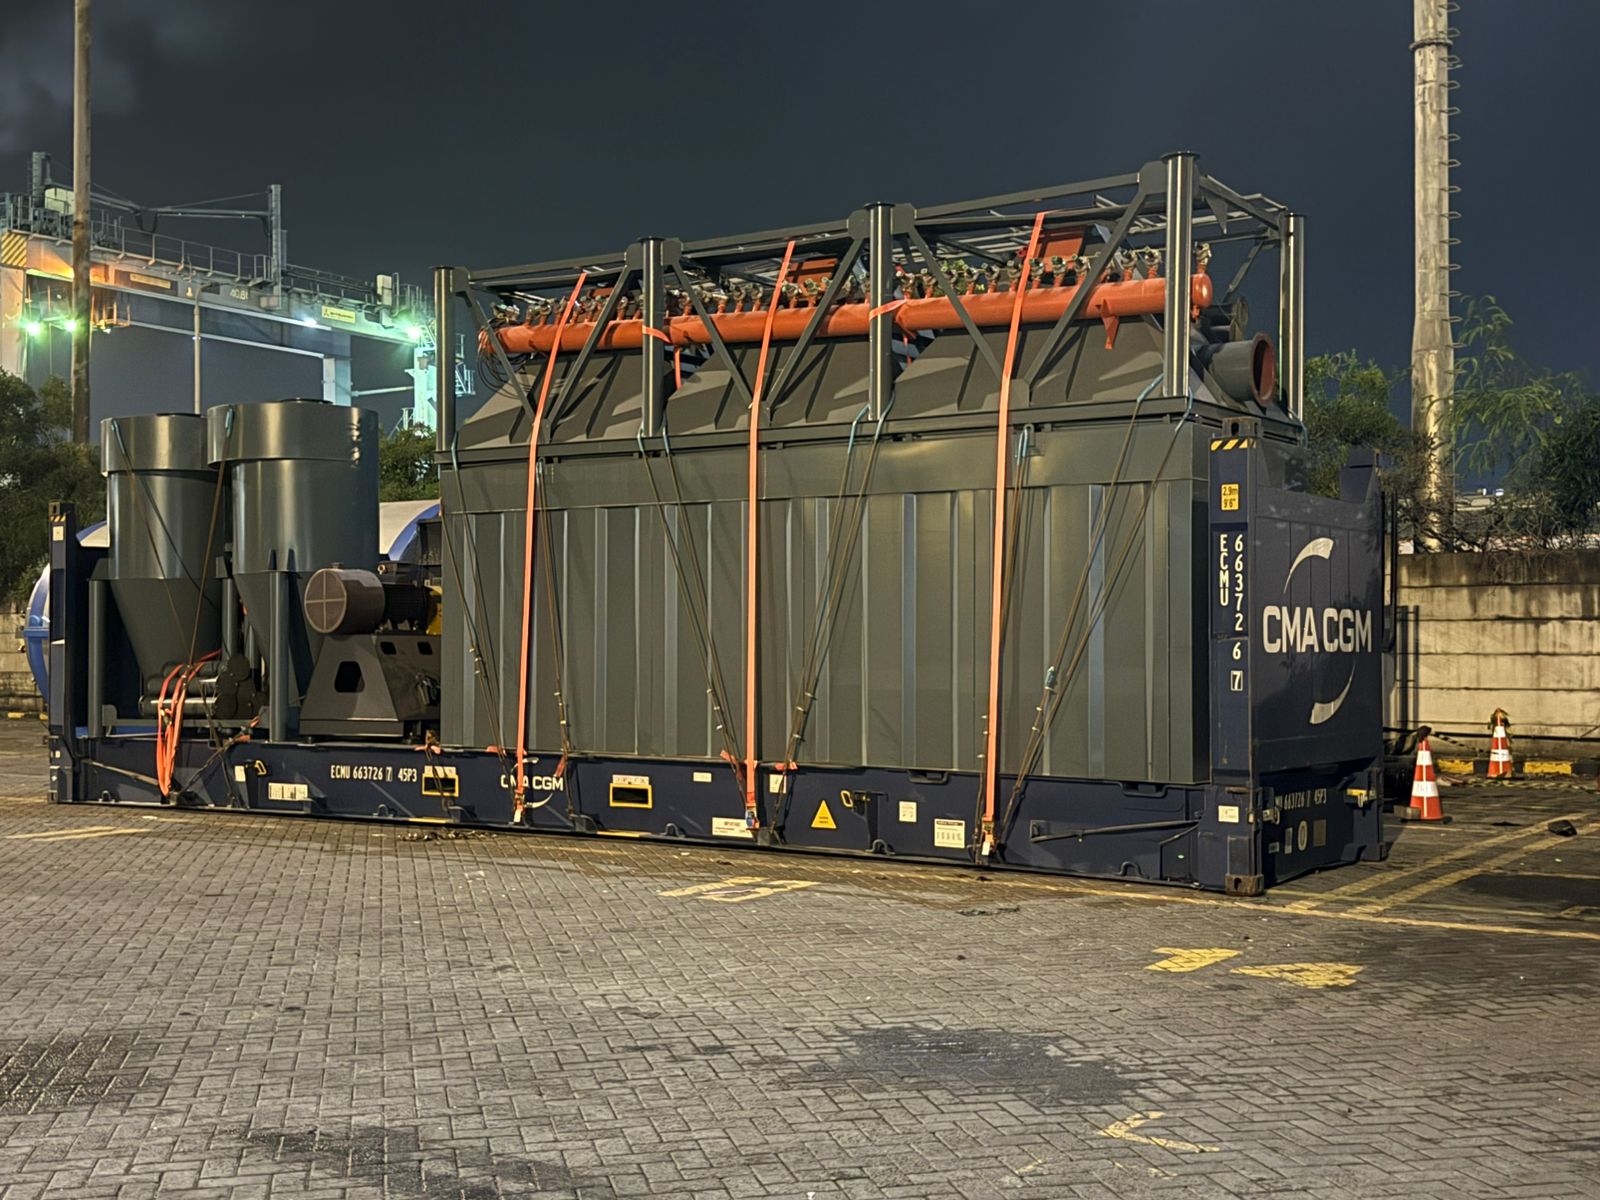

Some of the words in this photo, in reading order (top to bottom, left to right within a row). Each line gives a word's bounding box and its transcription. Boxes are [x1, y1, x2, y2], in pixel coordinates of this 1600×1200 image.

[1223, 486, 1238, 496] 2.9m
[1219, 534, 1230, 606] ECMU
[1233, 534, 1244, 660] 663726
[1262, 605, 1319, 654] CMA
[1323, 607, 1372, 653] CGM
[1231, 670, 1243, 692] 7
[330, 764, 351, 779] ECMU
[352, 766, 383, 781] 663726
[386, 766, 393, 782] 7
[397, 768, 418, 782] 45P3
[532, 776, 564, 791] CGM
